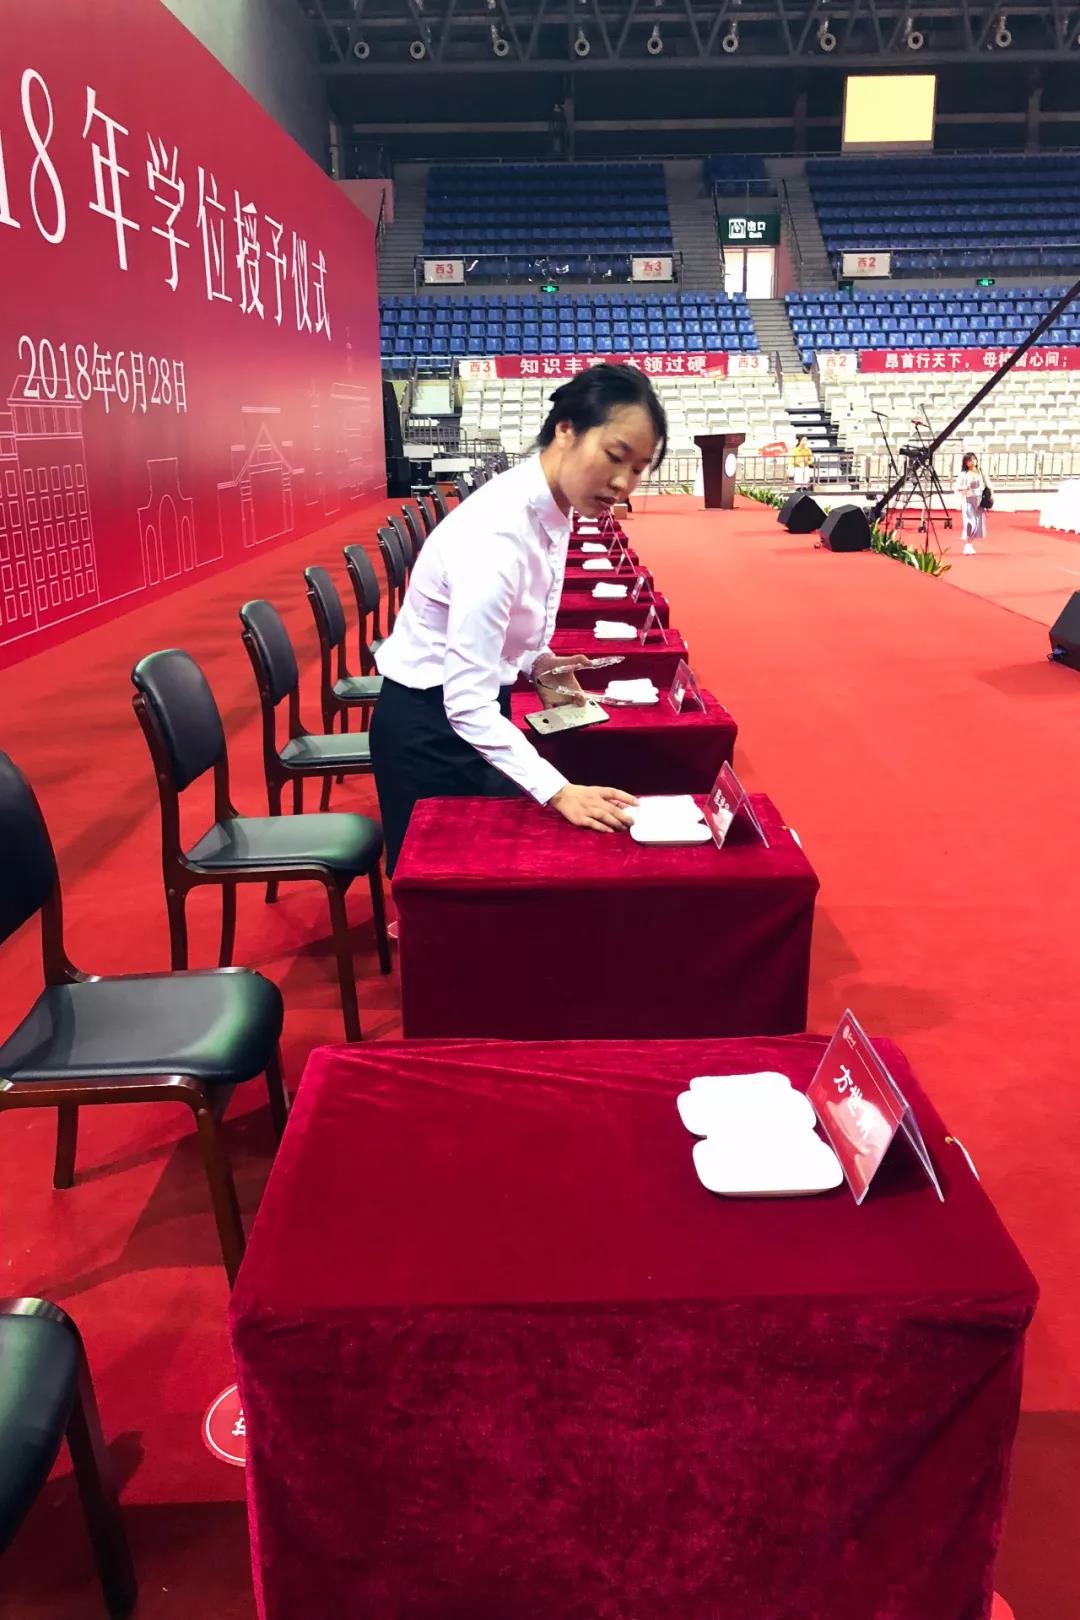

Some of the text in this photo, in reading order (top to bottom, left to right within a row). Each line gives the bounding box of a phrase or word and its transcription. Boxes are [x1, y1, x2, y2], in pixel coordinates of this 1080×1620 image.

[747, 221, 766, 231] 出口
[643, 261, 662, 272] 西3
[857, 256, 876, 268] 西2
[435, 263, 454, 274] 西3
[470, 361, 491, 373] 西3
[738, 356, 759, 368] 西3
[826, 355, 847, 367] 西2
[18, 335, 187, 413] 2018年6月28日
